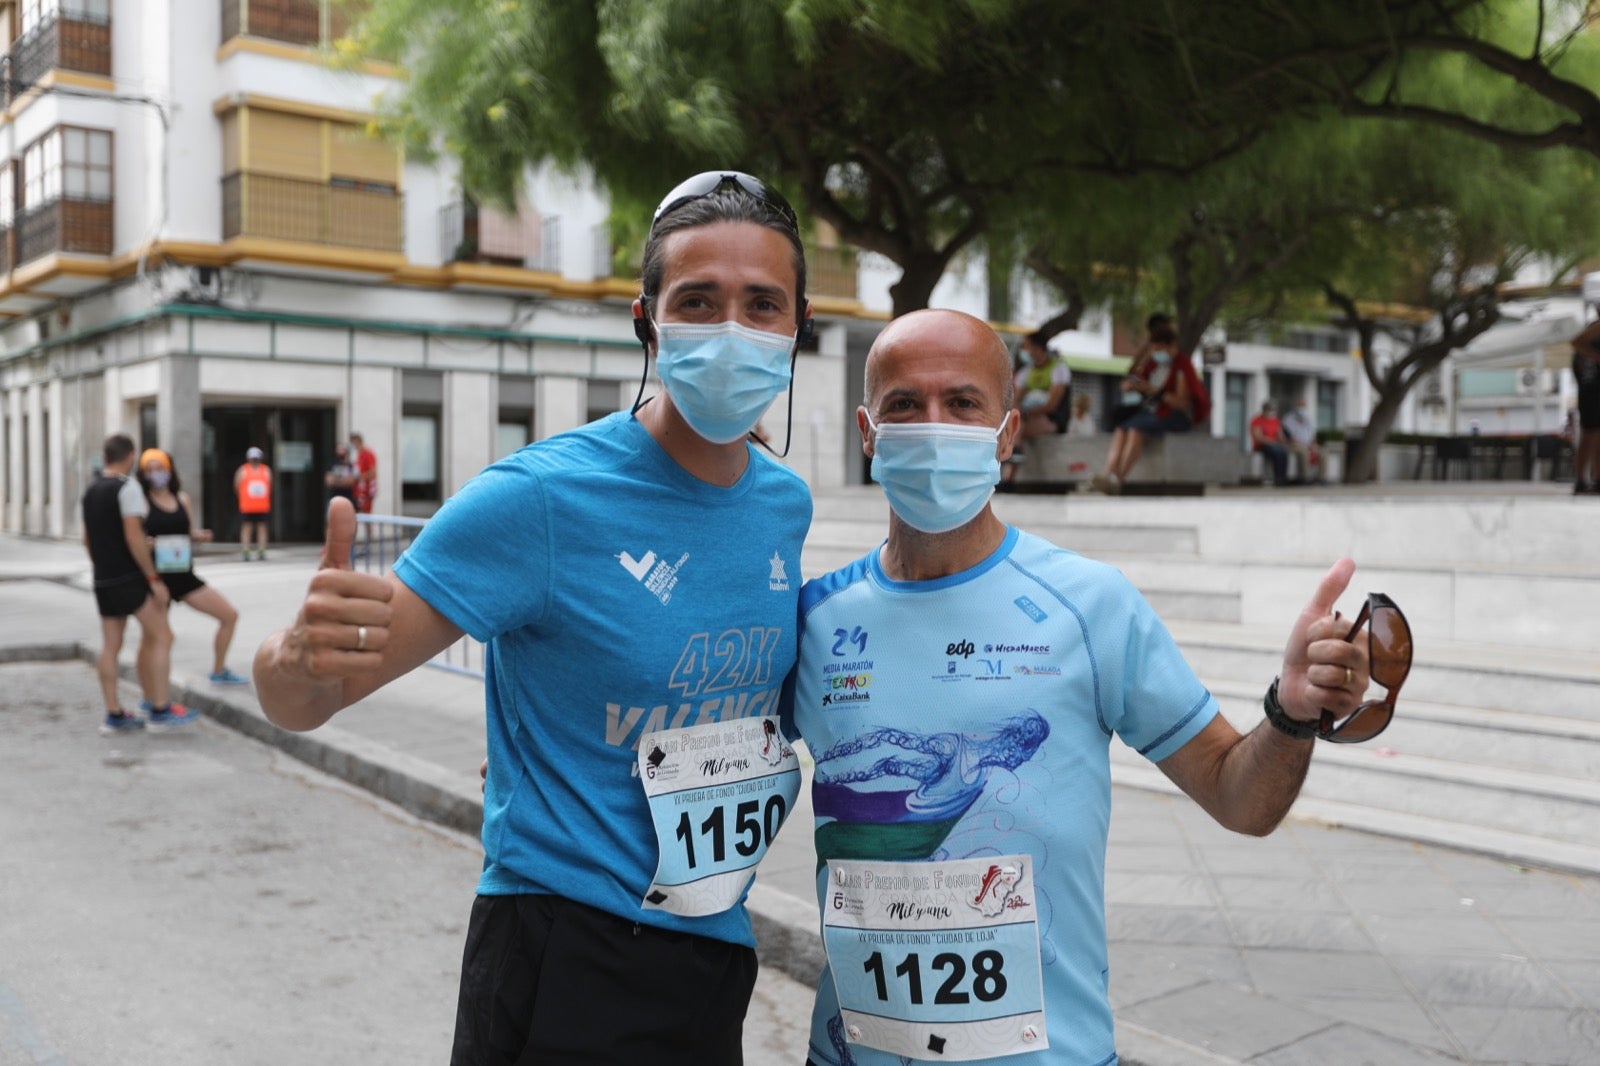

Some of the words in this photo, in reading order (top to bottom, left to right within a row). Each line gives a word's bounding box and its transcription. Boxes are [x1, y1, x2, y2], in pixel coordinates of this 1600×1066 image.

[832, 626, 868, 656] 24
[945, 639, 975, 659] edp
[668, 627, 782, 697] 42K
[823, 663, 840, 674] MEDIA
[842, 660, 874, 672] MARATÓN
[833, 692, 870, 702] CaixaBank
[606, 687, 781, 750] VALENCI
[682, 791, 706, 804] PRUEBA
[707, 789, 715, 800] DE
[716, 786, 735, 799] FONDO
[676, 794, 786, 869] 1150
[864, 871, 910, 890] PREMIO
[886, 902, 916, 920] Mil
[925, 905, 952, 920] una
[868, 932, 894, 945] PRUEBA
[896, 933, 905, 945] DE
[907, 934, 930, 945] FONDO
[965, 932, 975, 943] DE
[864, 950, 1007, 1005] 1128
